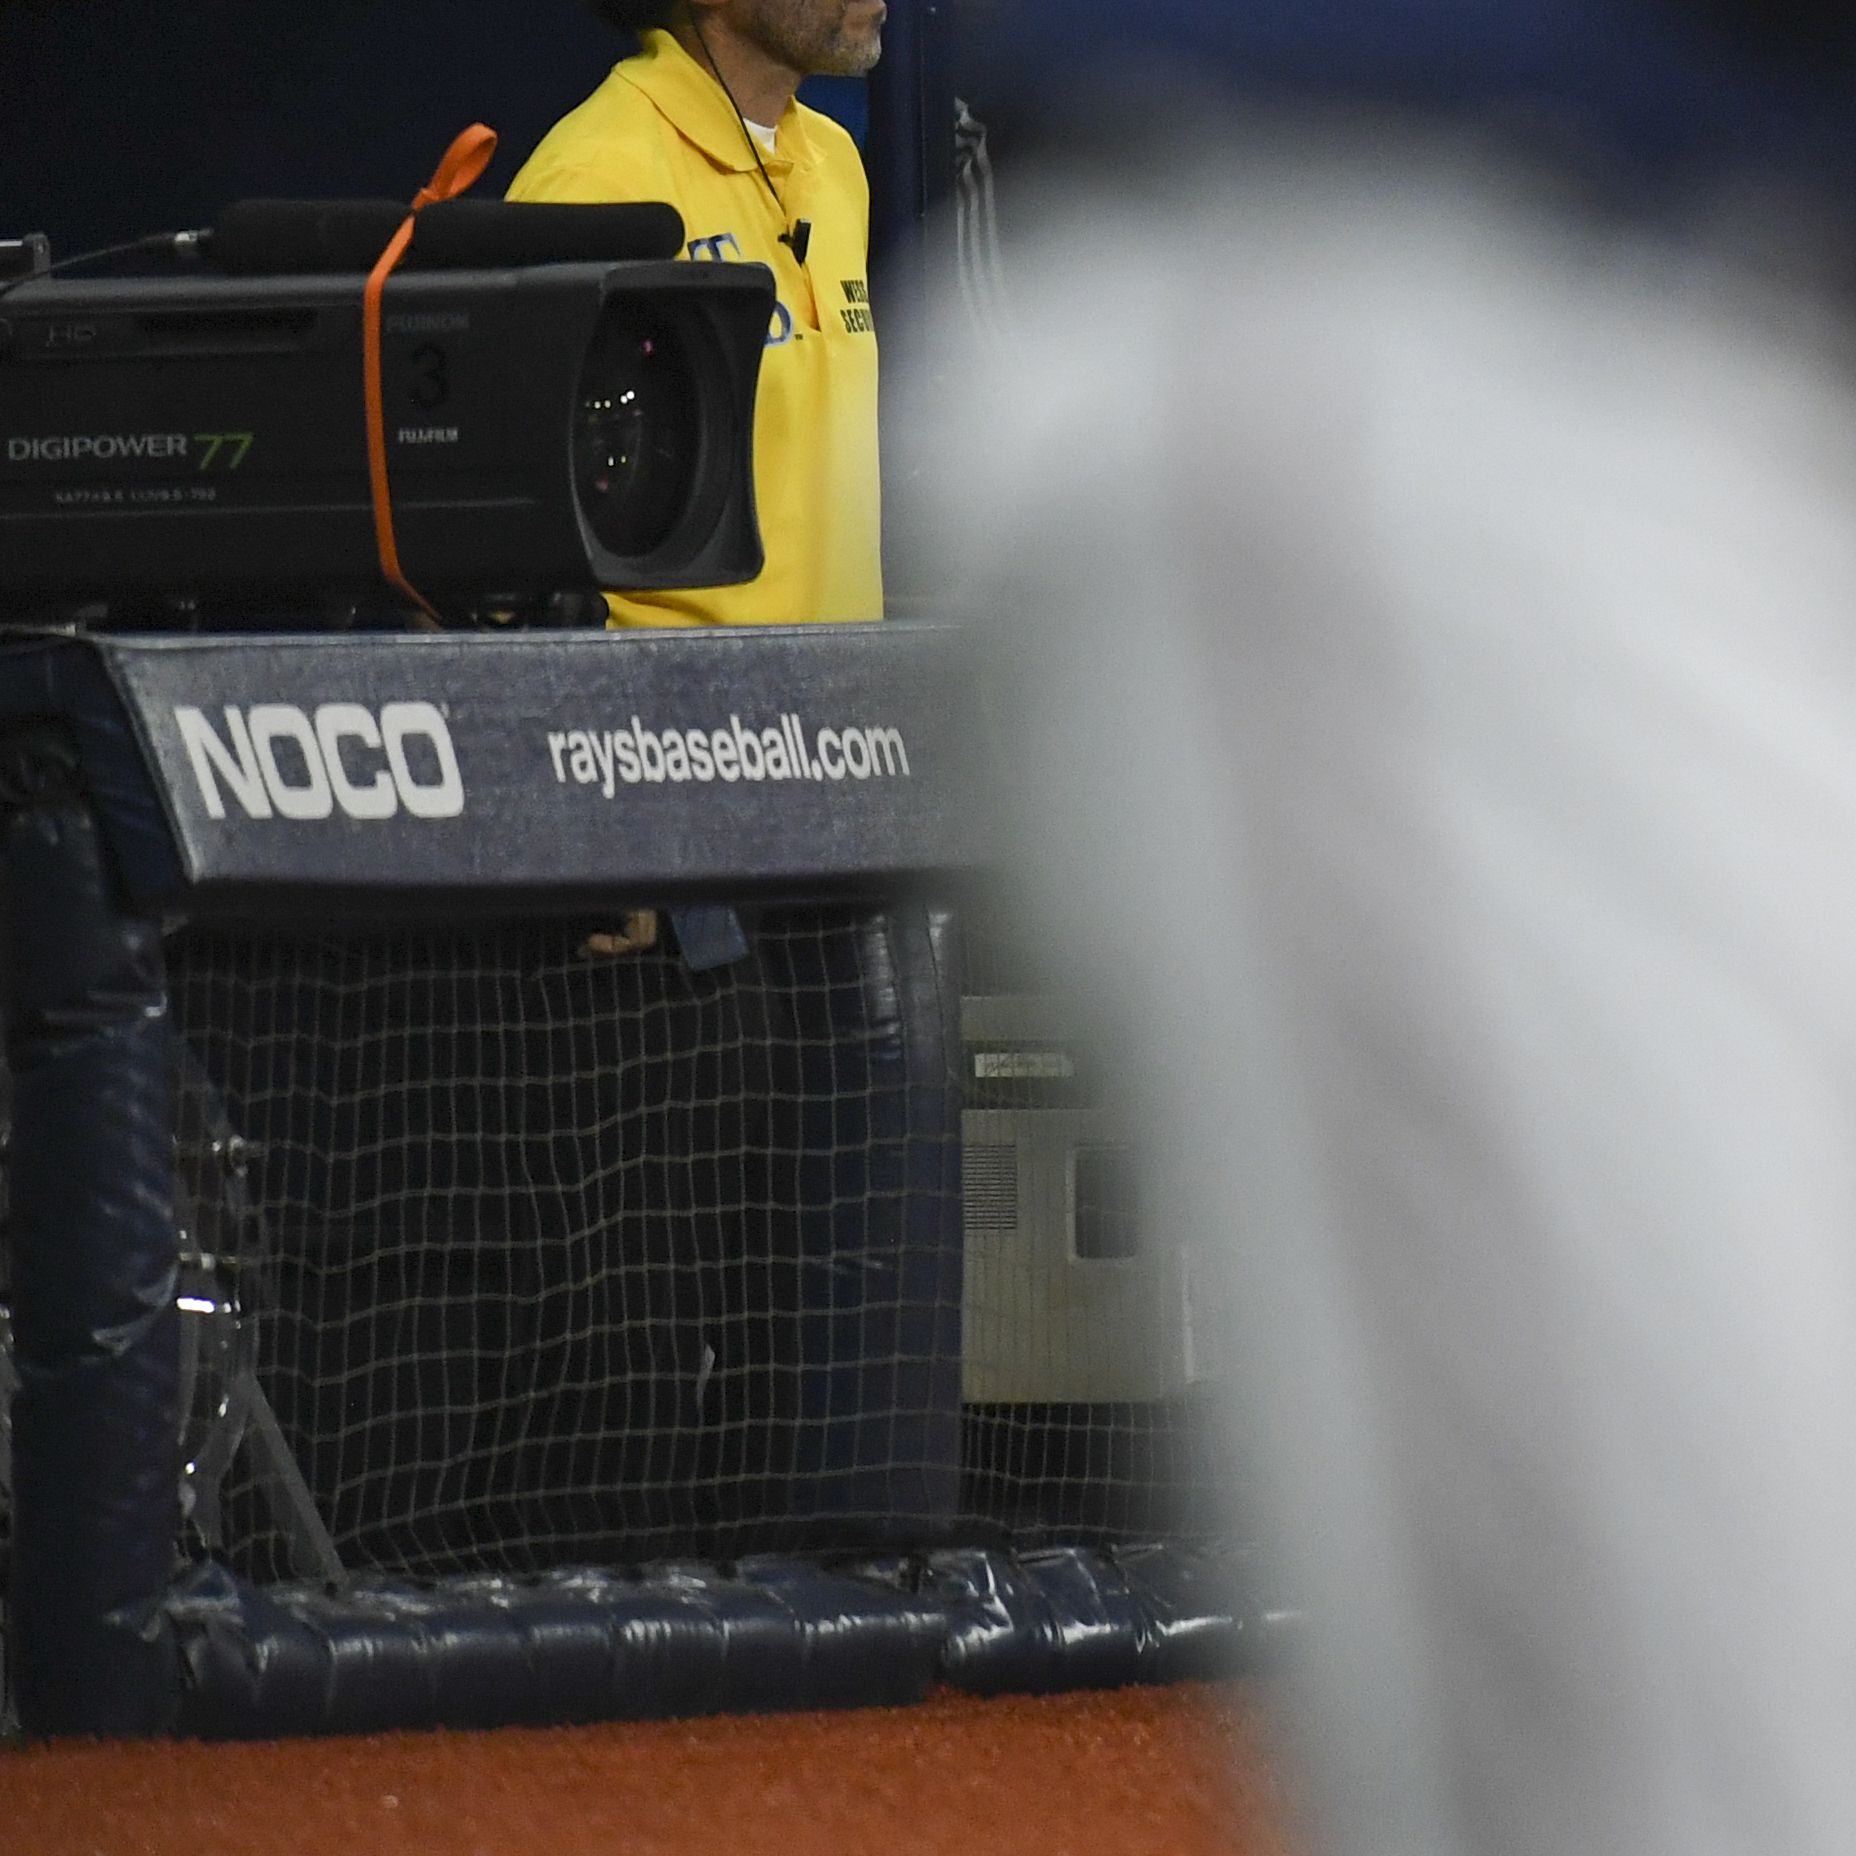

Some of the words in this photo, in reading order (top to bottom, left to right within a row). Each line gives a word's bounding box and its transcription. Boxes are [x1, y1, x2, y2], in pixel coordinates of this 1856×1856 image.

[409, 342, 449, 409] 3
[8, 433, 188, 460] DIGIPOWER
[192, 431, 254, 471] 77
[174, 701, 465, 819] NOCO
[547, 714, 910, 799] raysbaseball.com
